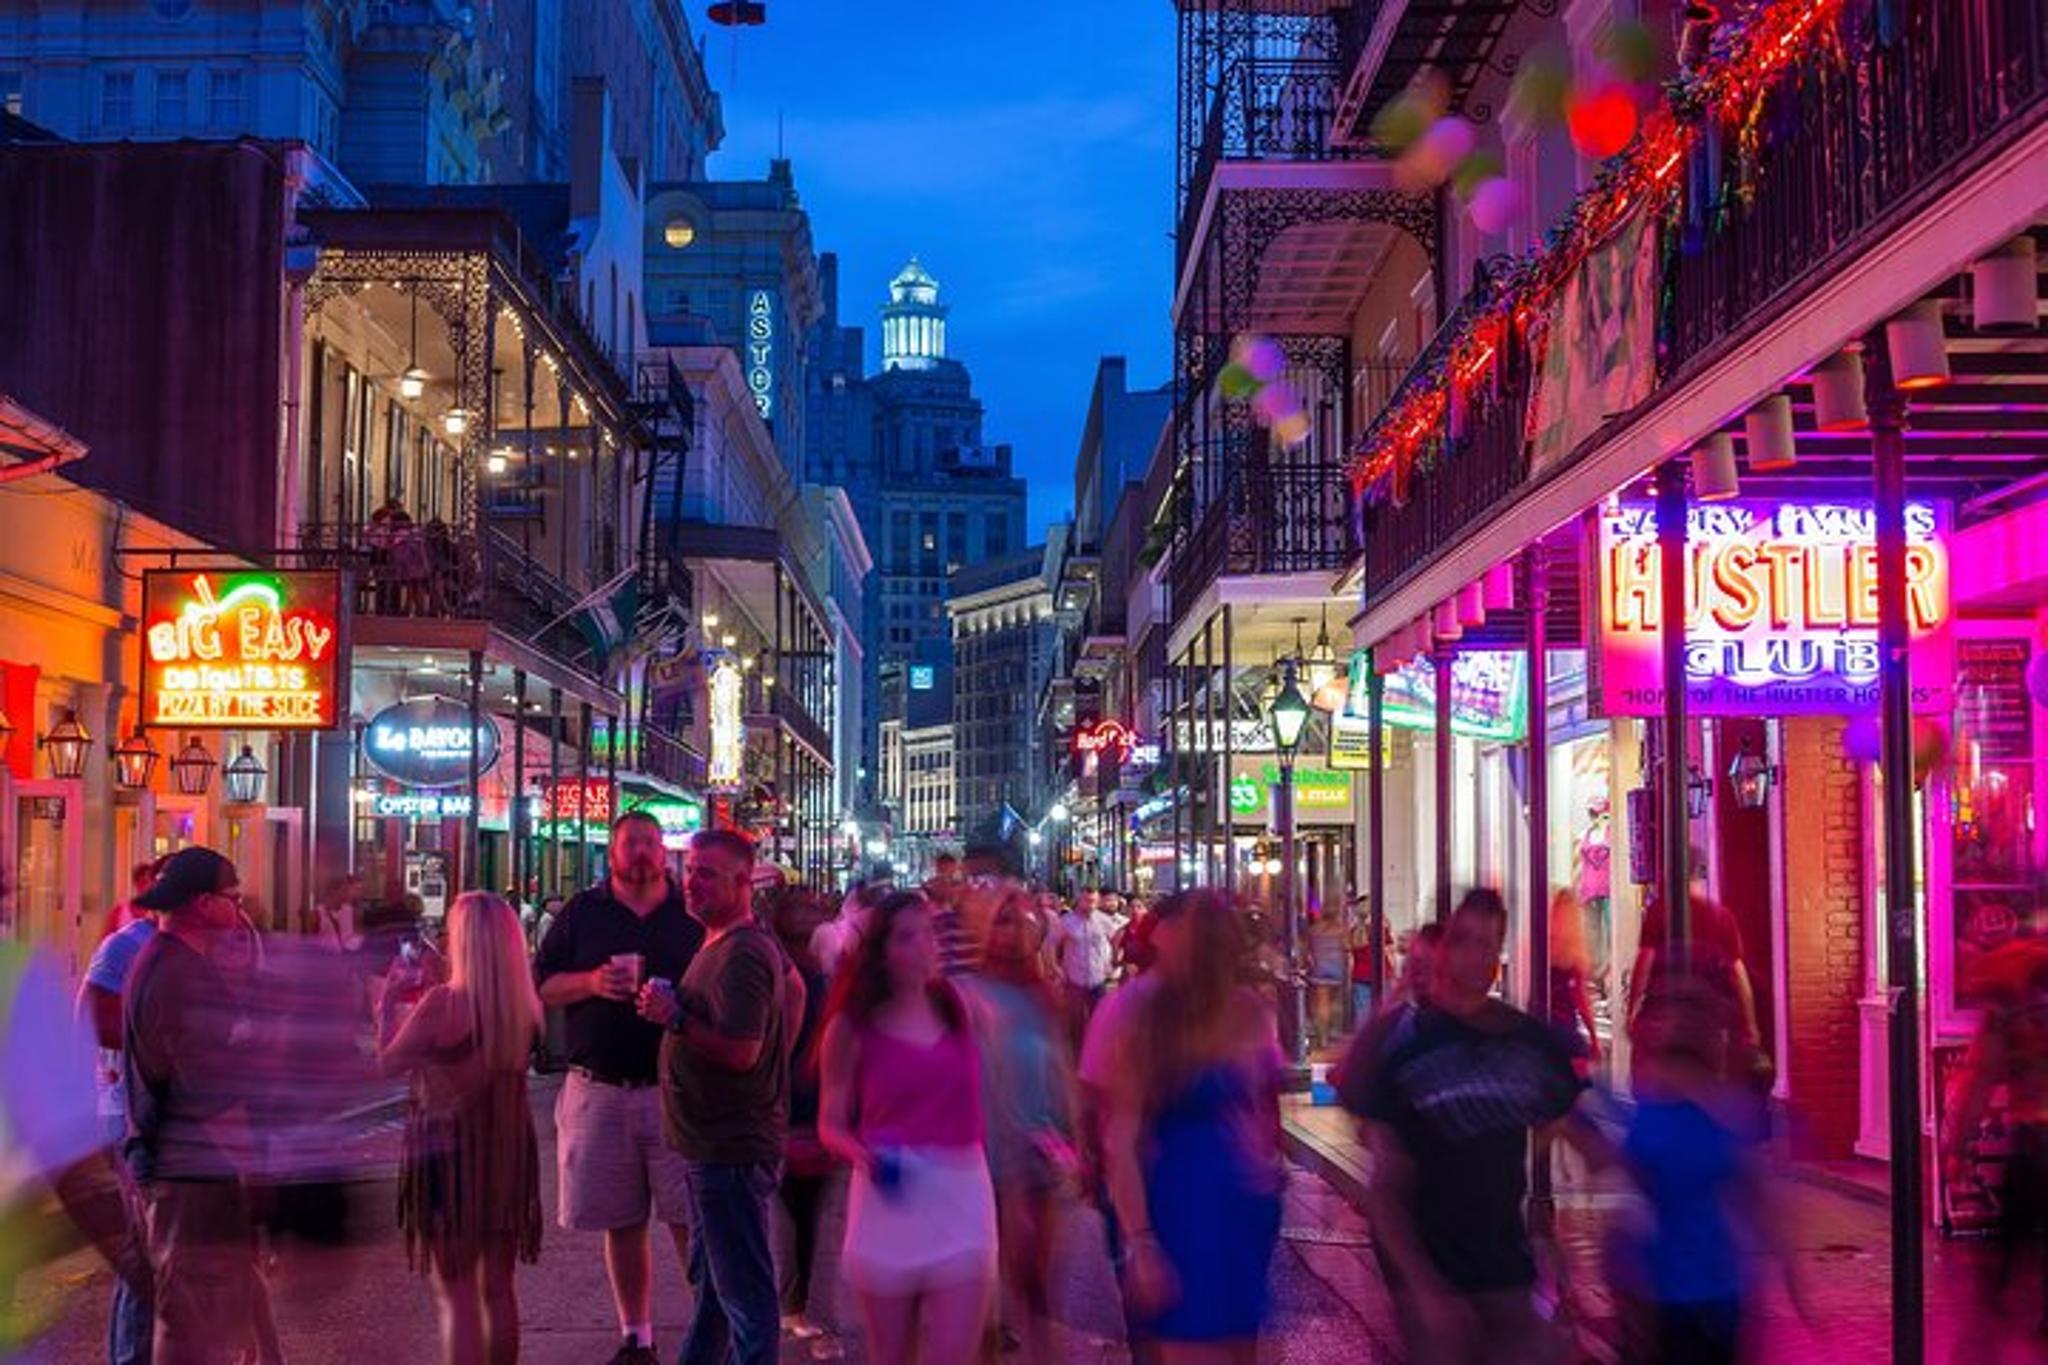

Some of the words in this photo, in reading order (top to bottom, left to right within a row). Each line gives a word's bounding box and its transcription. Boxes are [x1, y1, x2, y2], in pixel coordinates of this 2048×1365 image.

[749, 290, 771, 418] ASTOR
[148, 610, 223, 661] BIG
[240, 607, 331, 661] EASY
[1724, 687, 1758, 703] THE
[1766, 687, 1847, 703] HUSTLER
